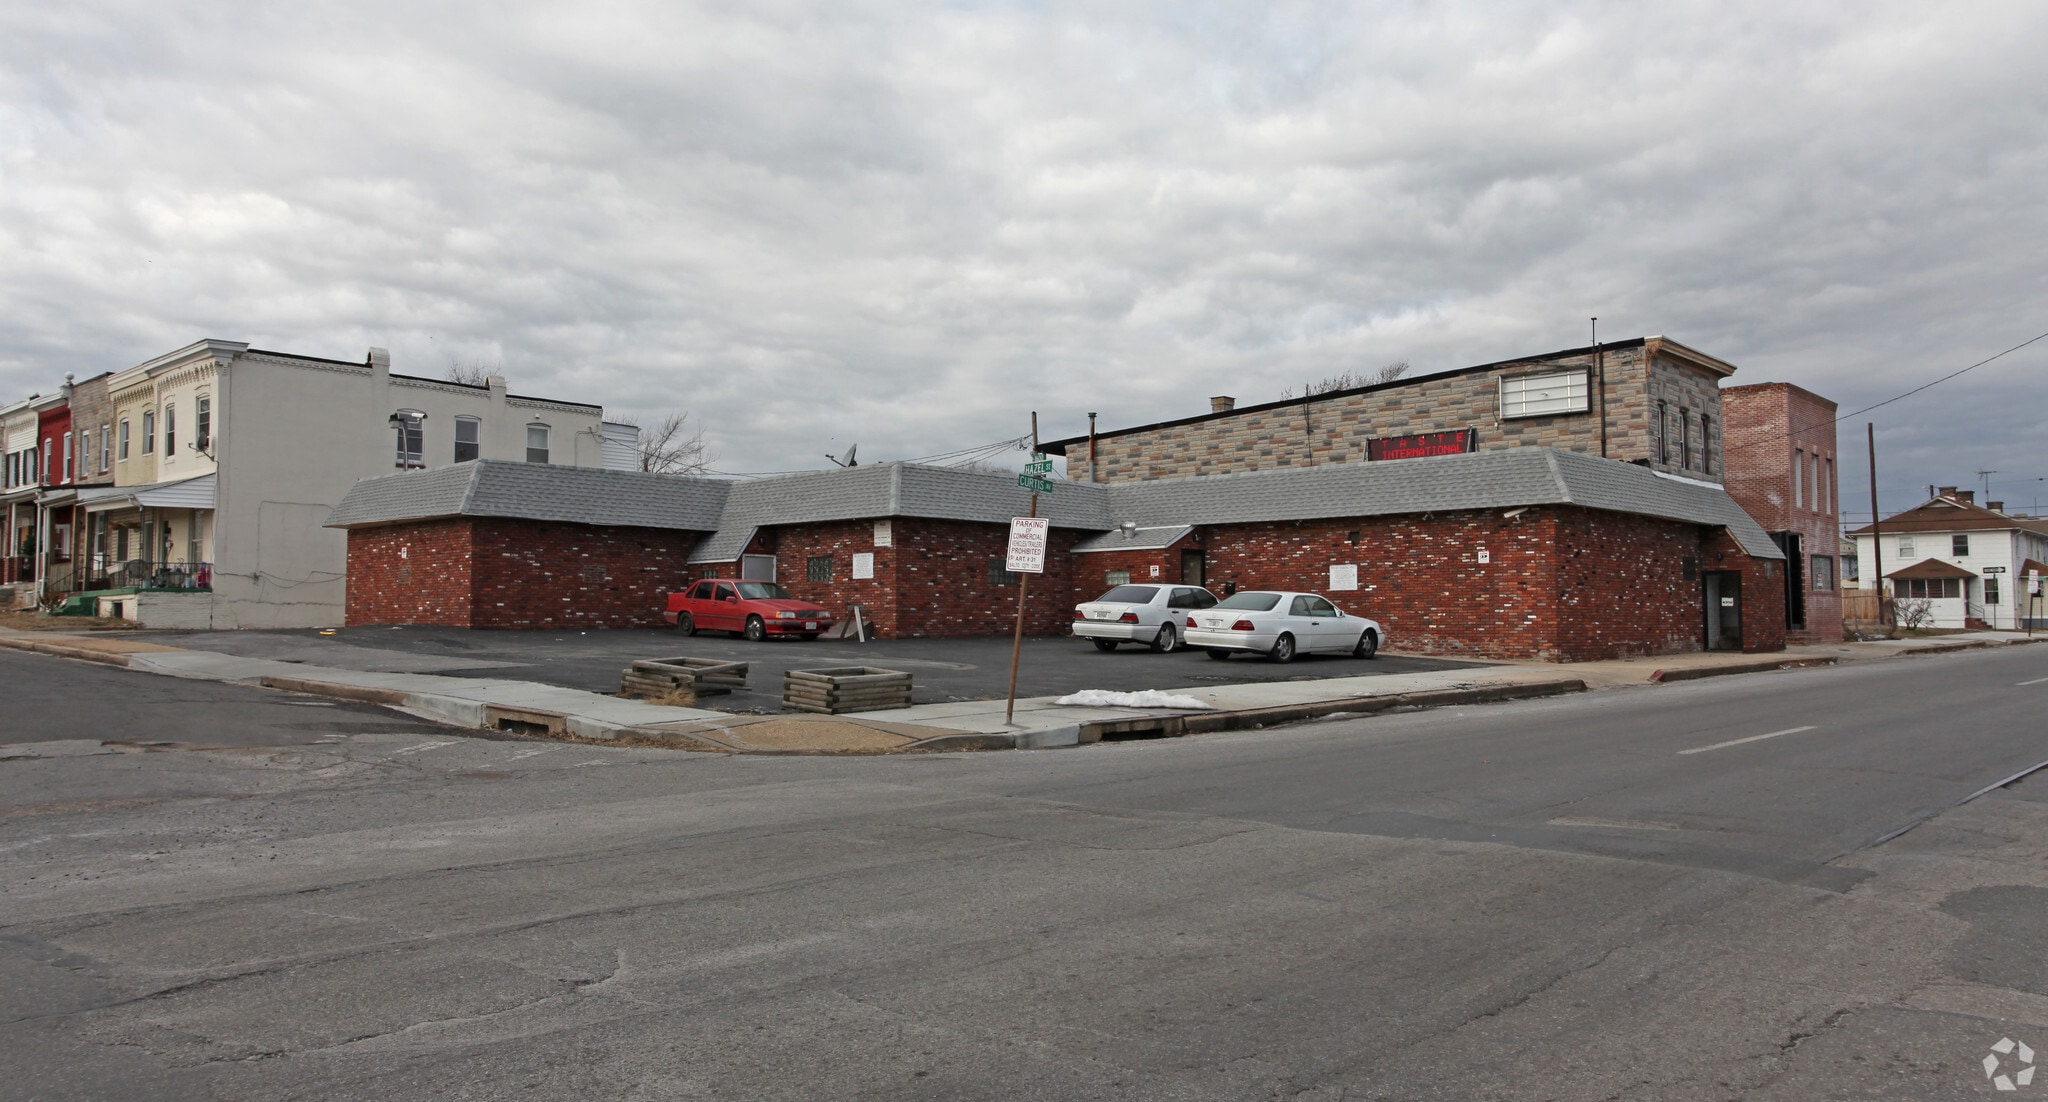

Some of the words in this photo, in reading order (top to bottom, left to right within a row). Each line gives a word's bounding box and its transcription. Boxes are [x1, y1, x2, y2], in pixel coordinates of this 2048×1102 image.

[1382, 444, 1463, 460] INTERNATIONAL
[1025, 462, 1045, 475] HAZEL
[1019, 476, 1045, 490] CURTIS
[1015, 520, 1044, 528] PARKING
[1013, 533, 1043, 541] COMMERCIAL
[1011, 547, 1041, 556] PROHIBITED
